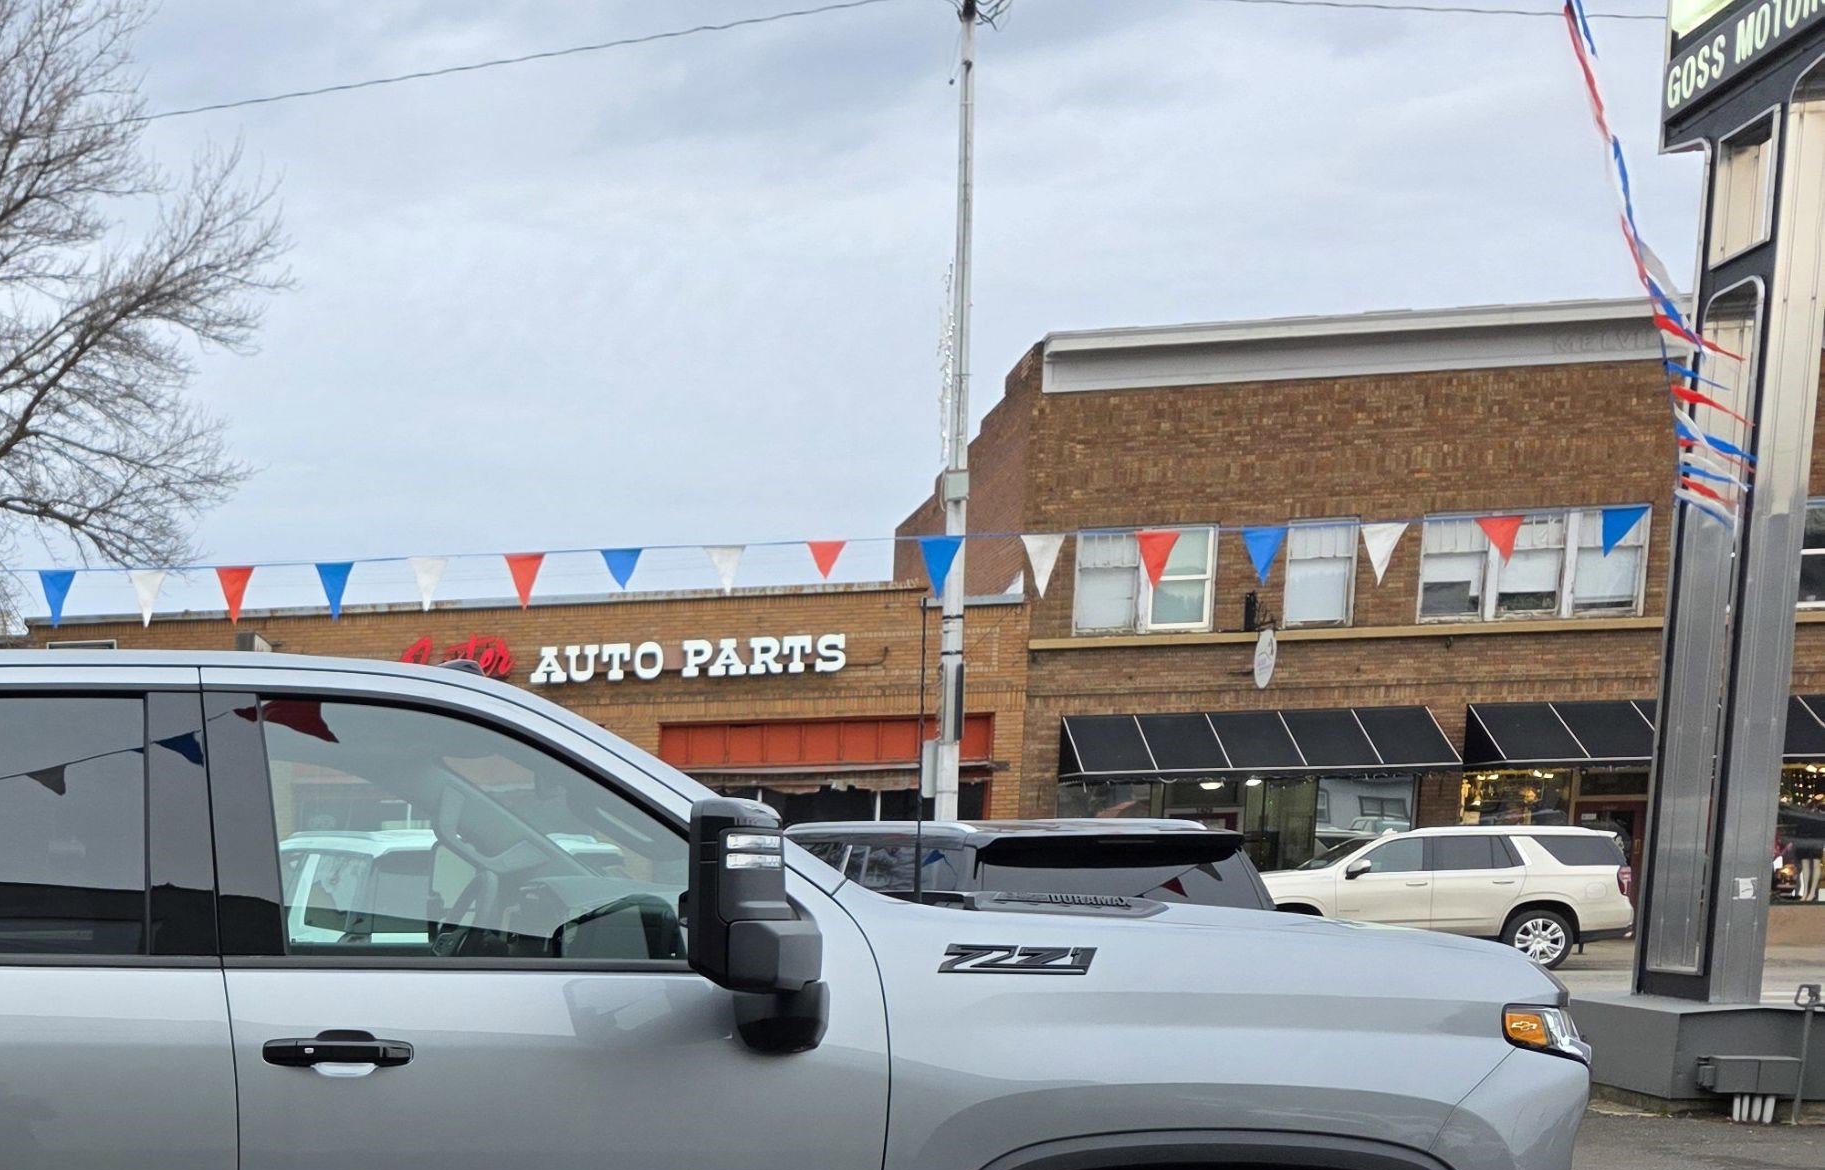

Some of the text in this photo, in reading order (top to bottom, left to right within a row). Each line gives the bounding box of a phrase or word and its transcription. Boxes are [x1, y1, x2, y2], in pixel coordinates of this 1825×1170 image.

[1667, 0, 1825, 109] GOSS MOTO
[529, 641, 664, 685] AUTO
[681, 633, 847, 677] PARTS
[937, 943, 1098, 975] Z71
